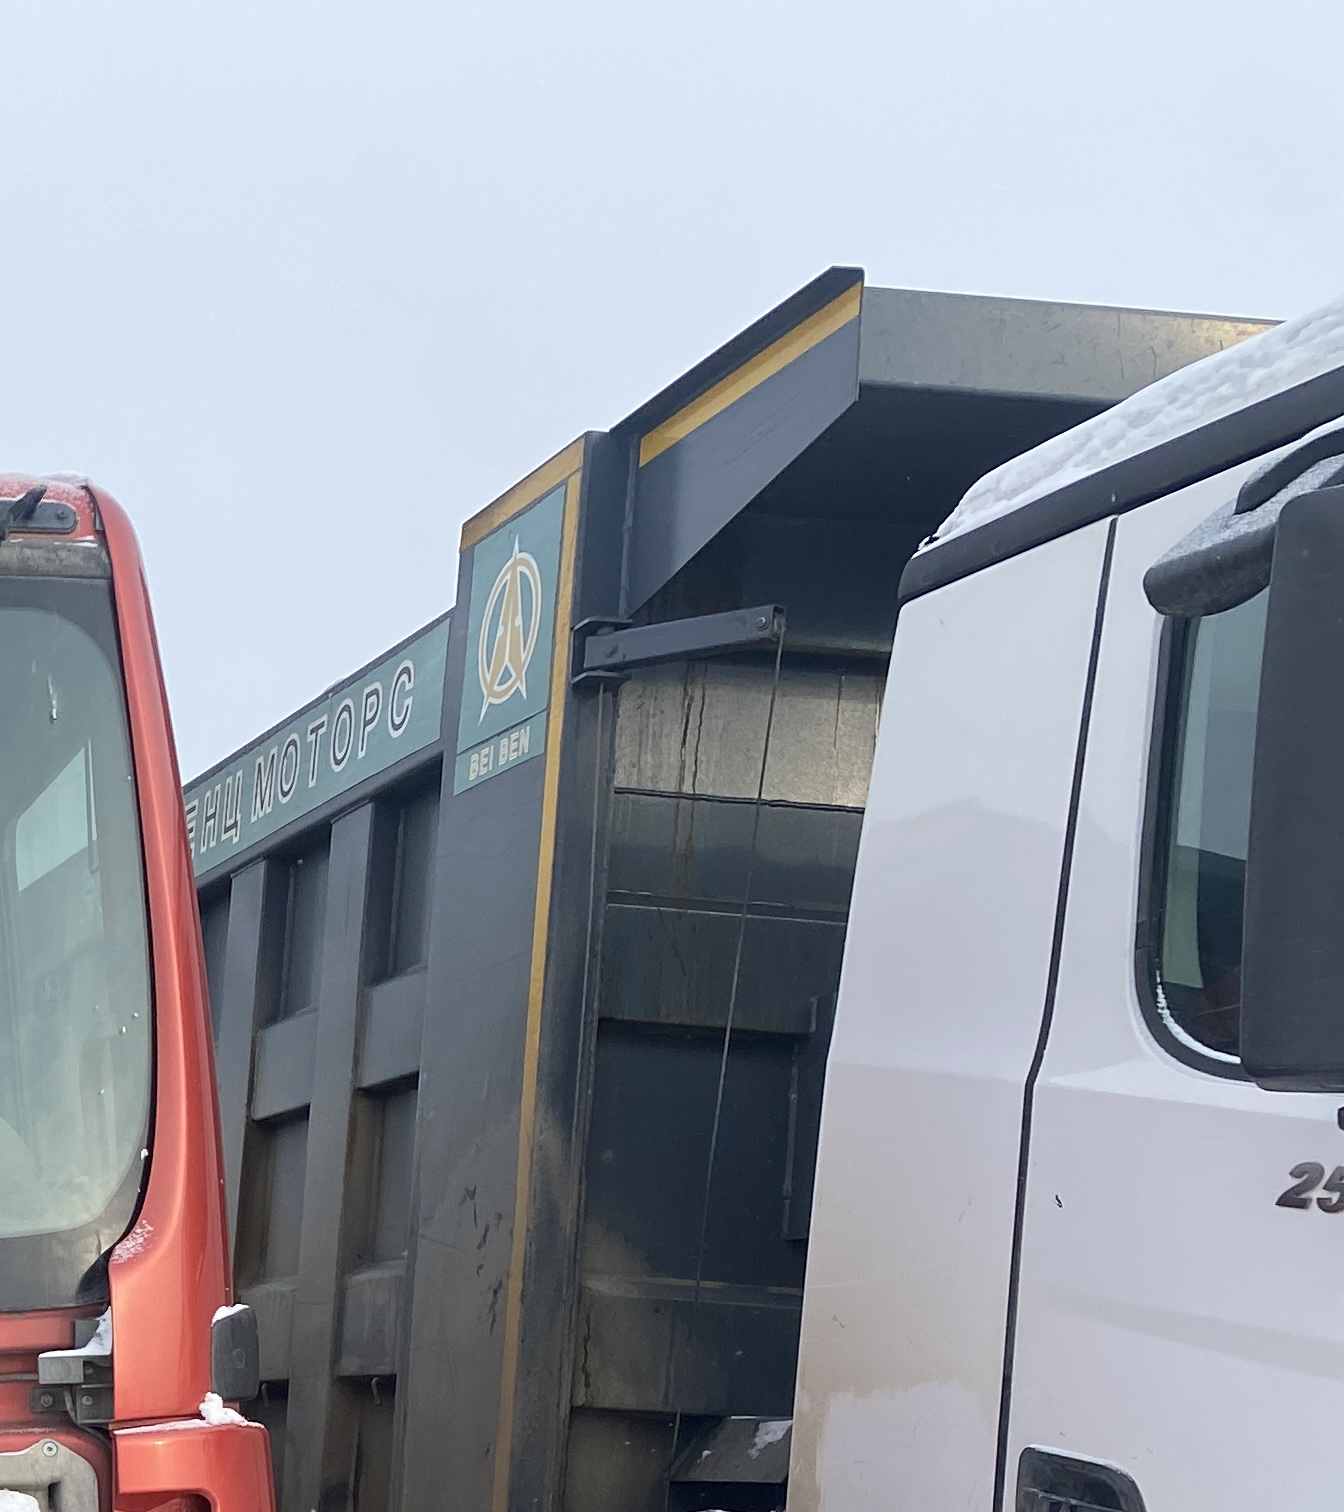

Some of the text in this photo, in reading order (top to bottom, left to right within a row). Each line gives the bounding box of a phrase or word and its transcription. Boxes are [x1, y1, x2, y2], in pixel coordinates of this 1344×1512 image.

[250, 659, 415, 824] МОТОРС
[469, 725, 531, 781] BEI BEN
